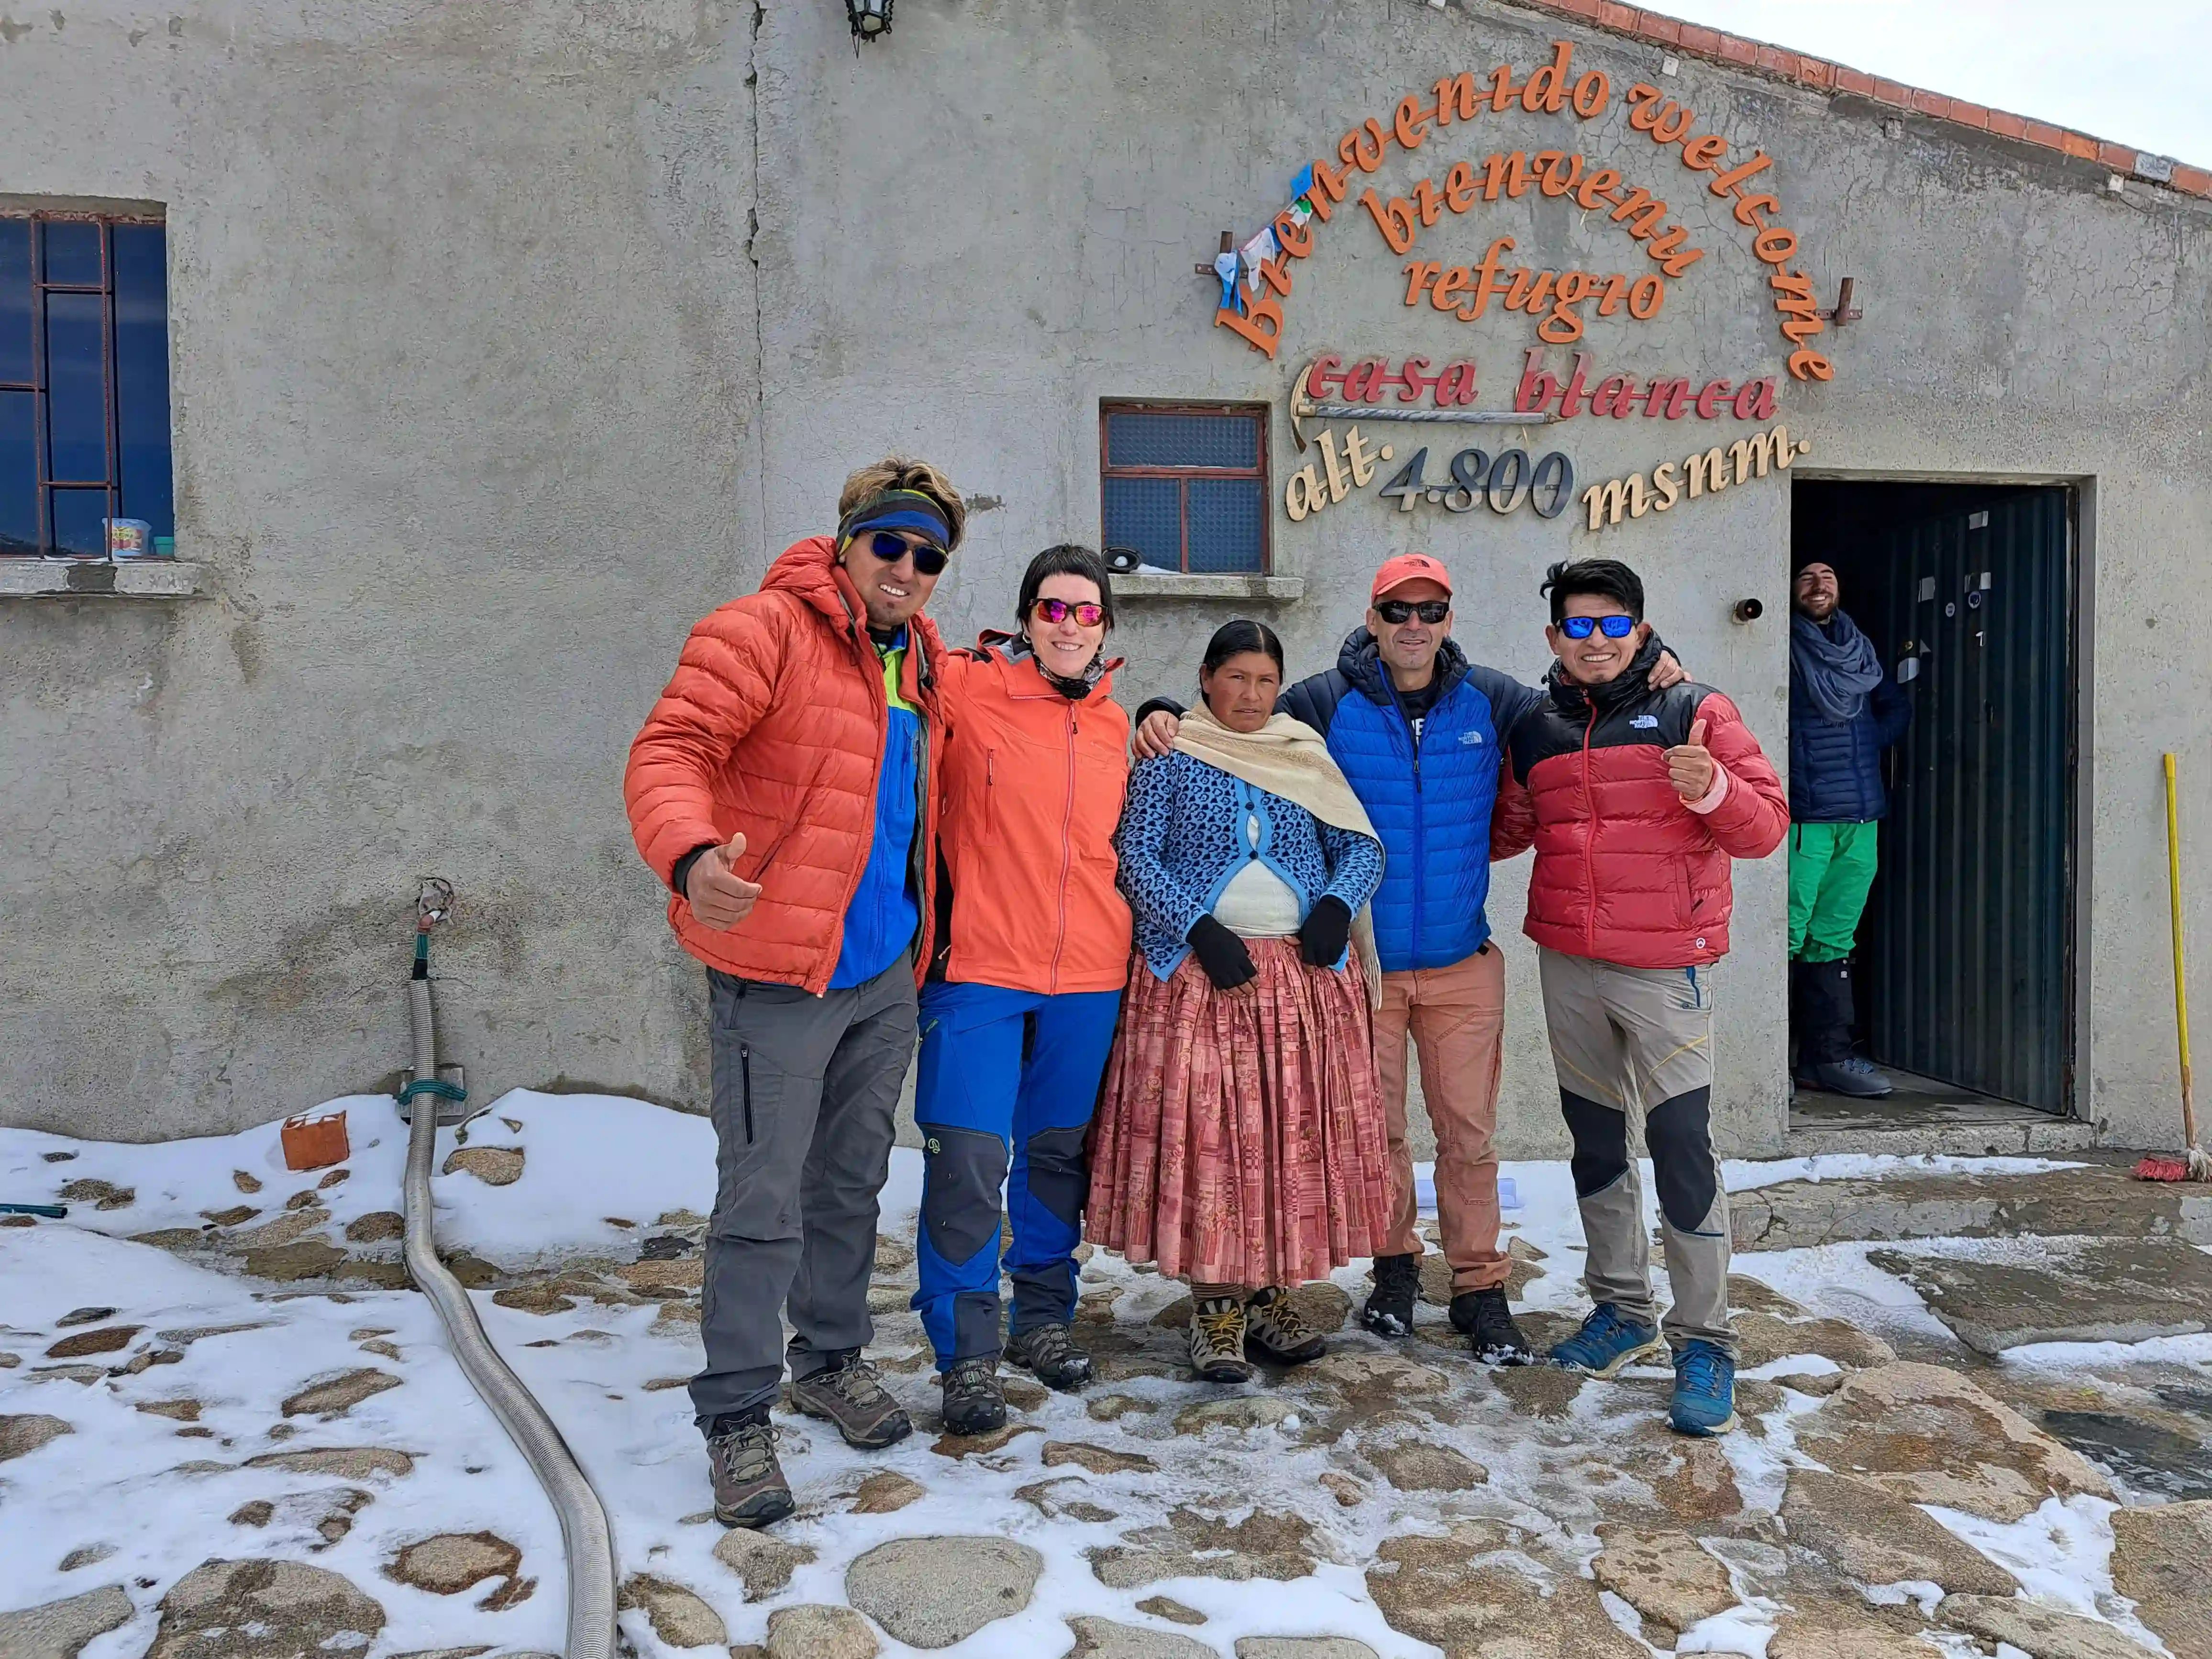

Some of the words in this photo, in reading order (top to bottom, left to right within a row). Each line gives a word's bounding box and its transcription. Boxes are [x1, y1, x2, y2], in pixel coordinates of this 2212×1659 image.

[1215, 41, 1610, 360] Bienvenido
[1628, 82, 1835, 382] welcome
[1360, 150, 1706, 277] bienvenu
[1403, 237, 1664, 343] refugio
[1307, 354, 1478, 407] casa
[1515, 347, 1778, 419] blanca
[1283, 425, 1394, 522] alt.
[1379, 447, 1574, 518] 4.800
[1582, 423, 1811, 531] msnm.
